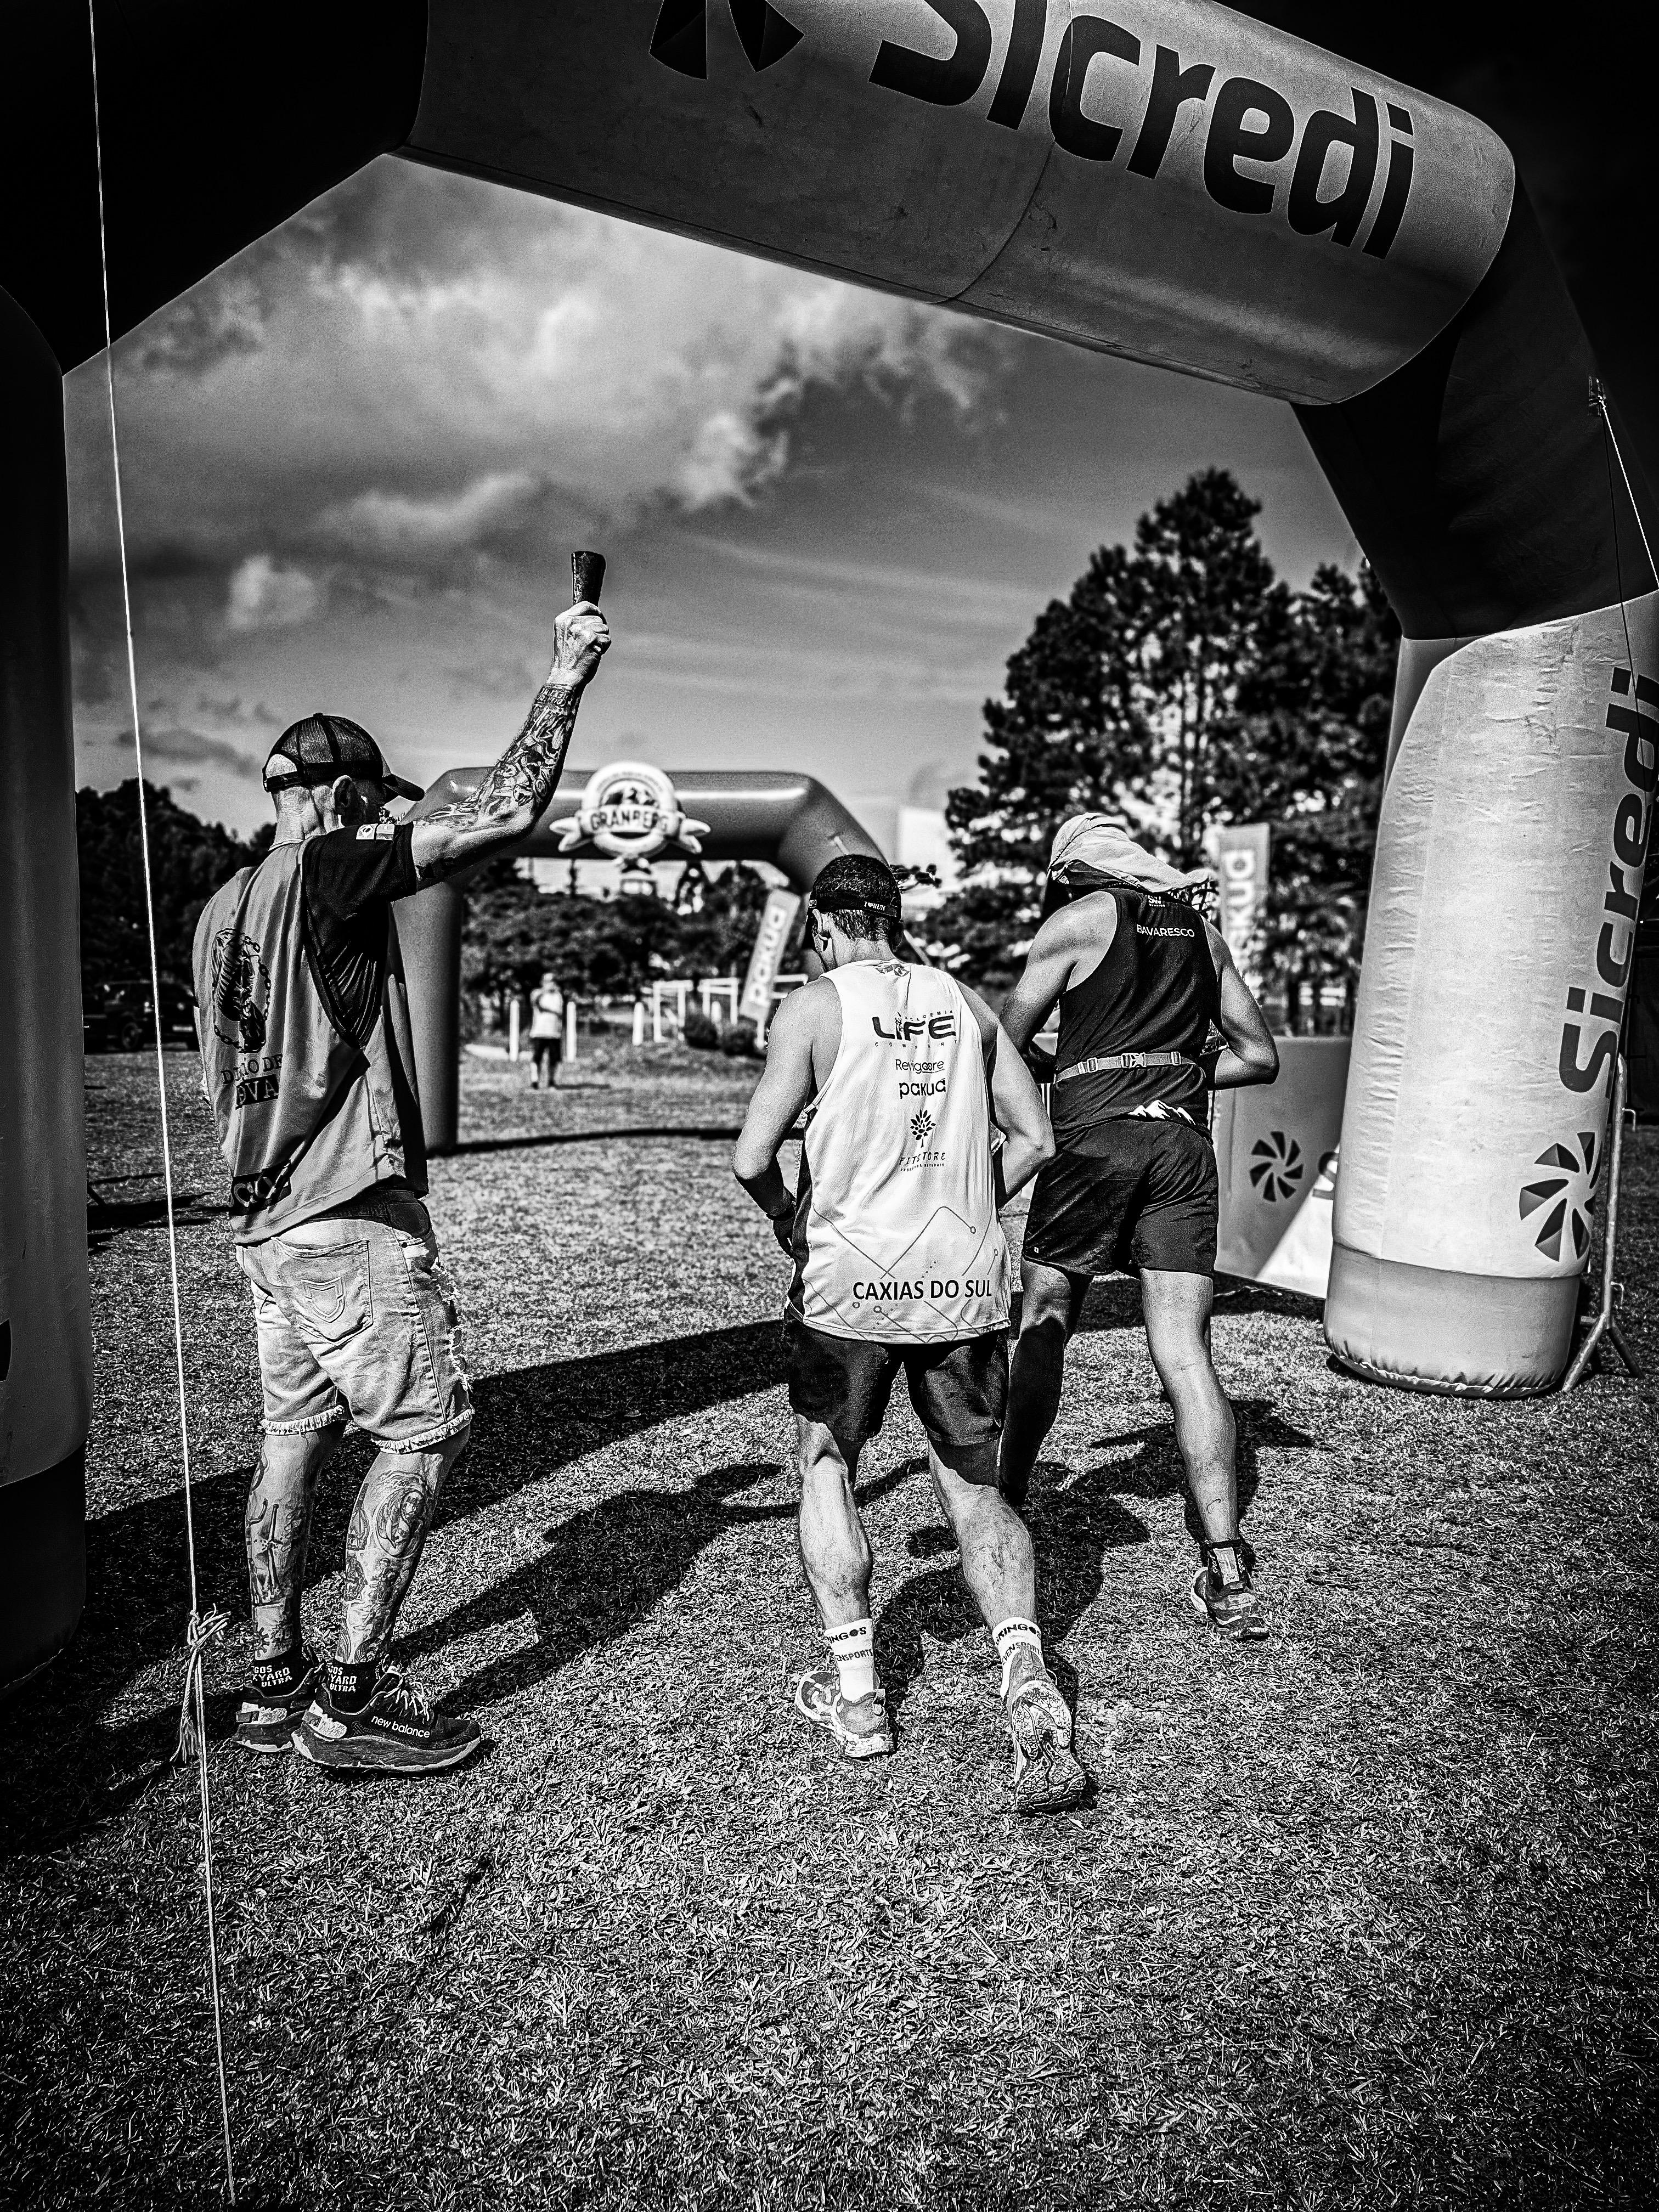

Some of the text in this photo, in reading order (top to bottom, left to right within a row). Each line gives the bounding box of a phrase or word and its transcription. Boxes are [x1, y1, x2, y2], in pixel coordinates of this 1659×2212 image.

[1136, 923, 1195, 938] BAVARESCO
[872, 1011, 956, 1041] LIFE
[853, 1279, 992, 1300] CAXIAS DO SUL
[261, 1675, 293, 1688] ULTRA
[330, 1683, 356, 1693] ULTRA
[371, 1716, 430, 1738] new balance
